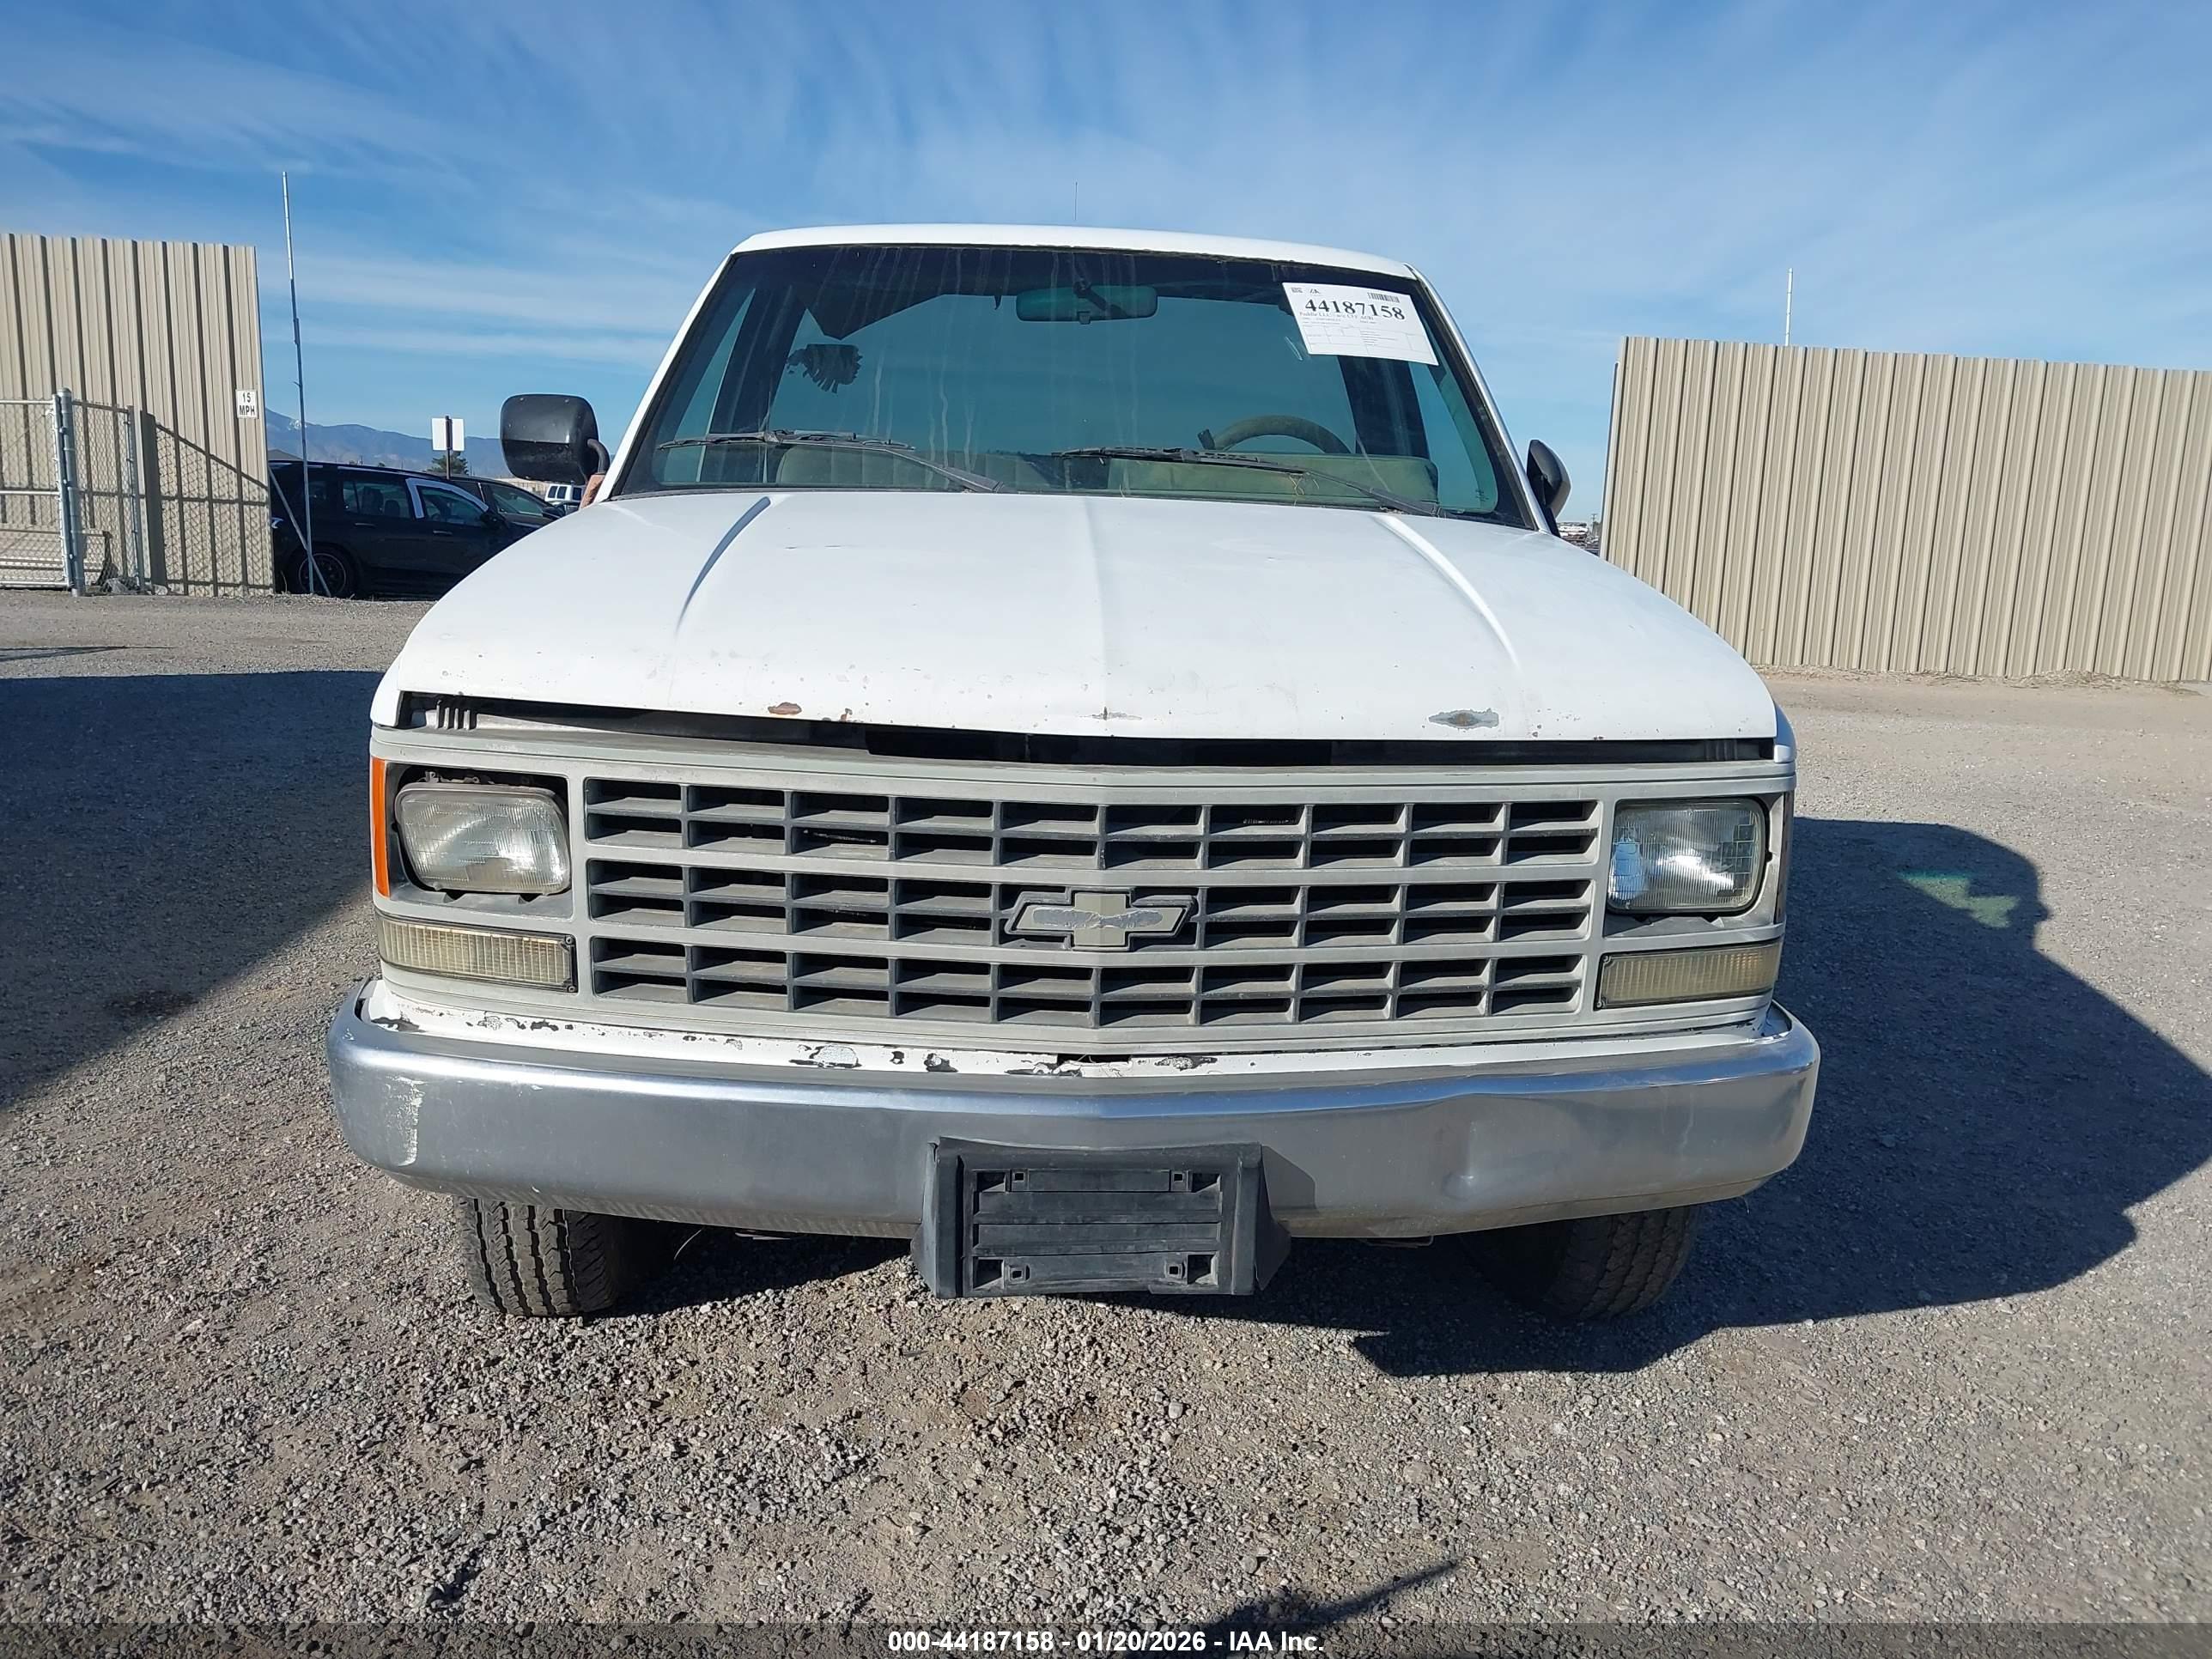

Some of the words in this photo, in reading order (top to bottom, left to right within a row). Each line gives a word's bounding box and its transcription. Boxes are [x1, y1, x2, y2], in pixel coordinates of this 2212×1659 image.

[1305, 298, 1406, 321] 44187158
[242, 392, 252, 403] 15
[239, 404, 256, 416] MPH
